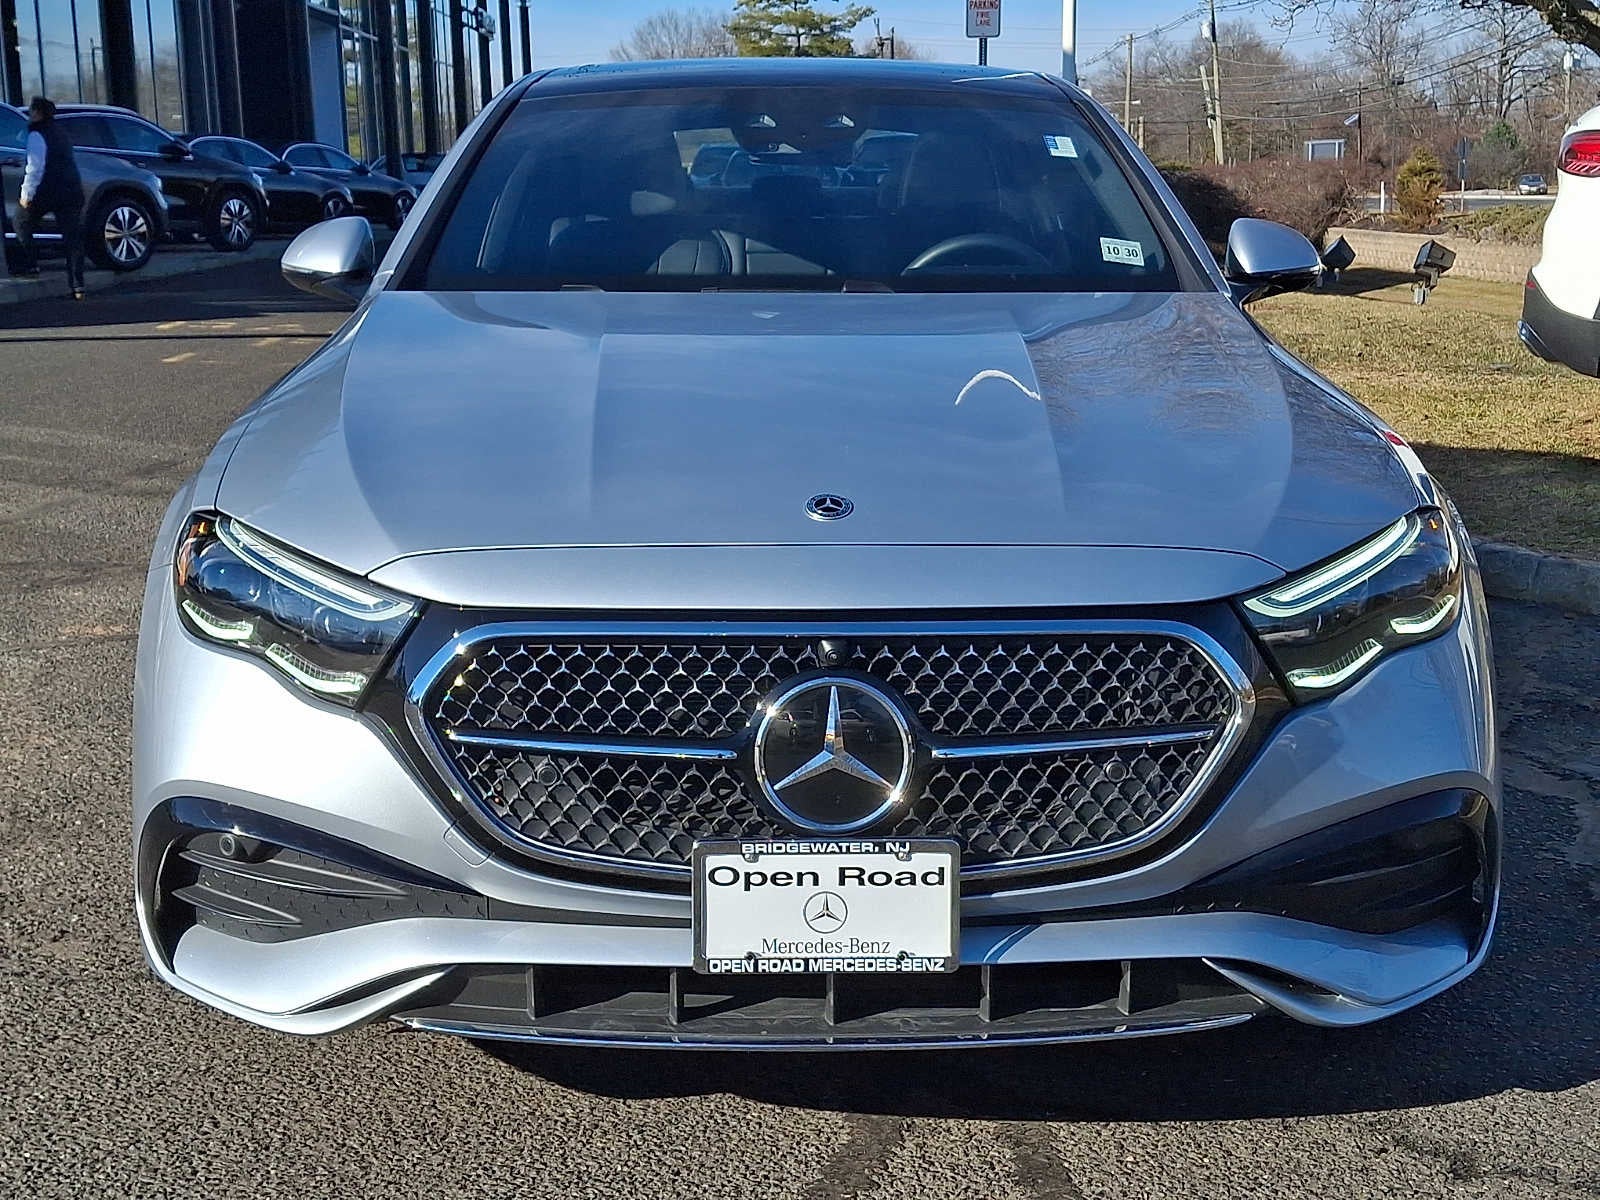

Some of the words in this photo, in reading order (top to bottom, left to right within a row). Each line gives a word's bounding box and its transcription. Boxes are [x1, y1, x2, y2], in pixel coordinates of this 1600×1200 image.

[969, 0, 999, 9] PARKING
[1107, 246, 1120, 256] 10
[1124, 248, 1138, 258] 30
[885, 842, 911, 853] NJ
[708, 866, 820, 891] Open
[838, 866, 945, 887] Road
[761, 937, 891, 954] Mercedes-Benz
[709, 959, 755, 973] OPEN
[760, 959, 804, 973] ROAD
[809, 958, 945, 972] MERCEDES-BENZ
